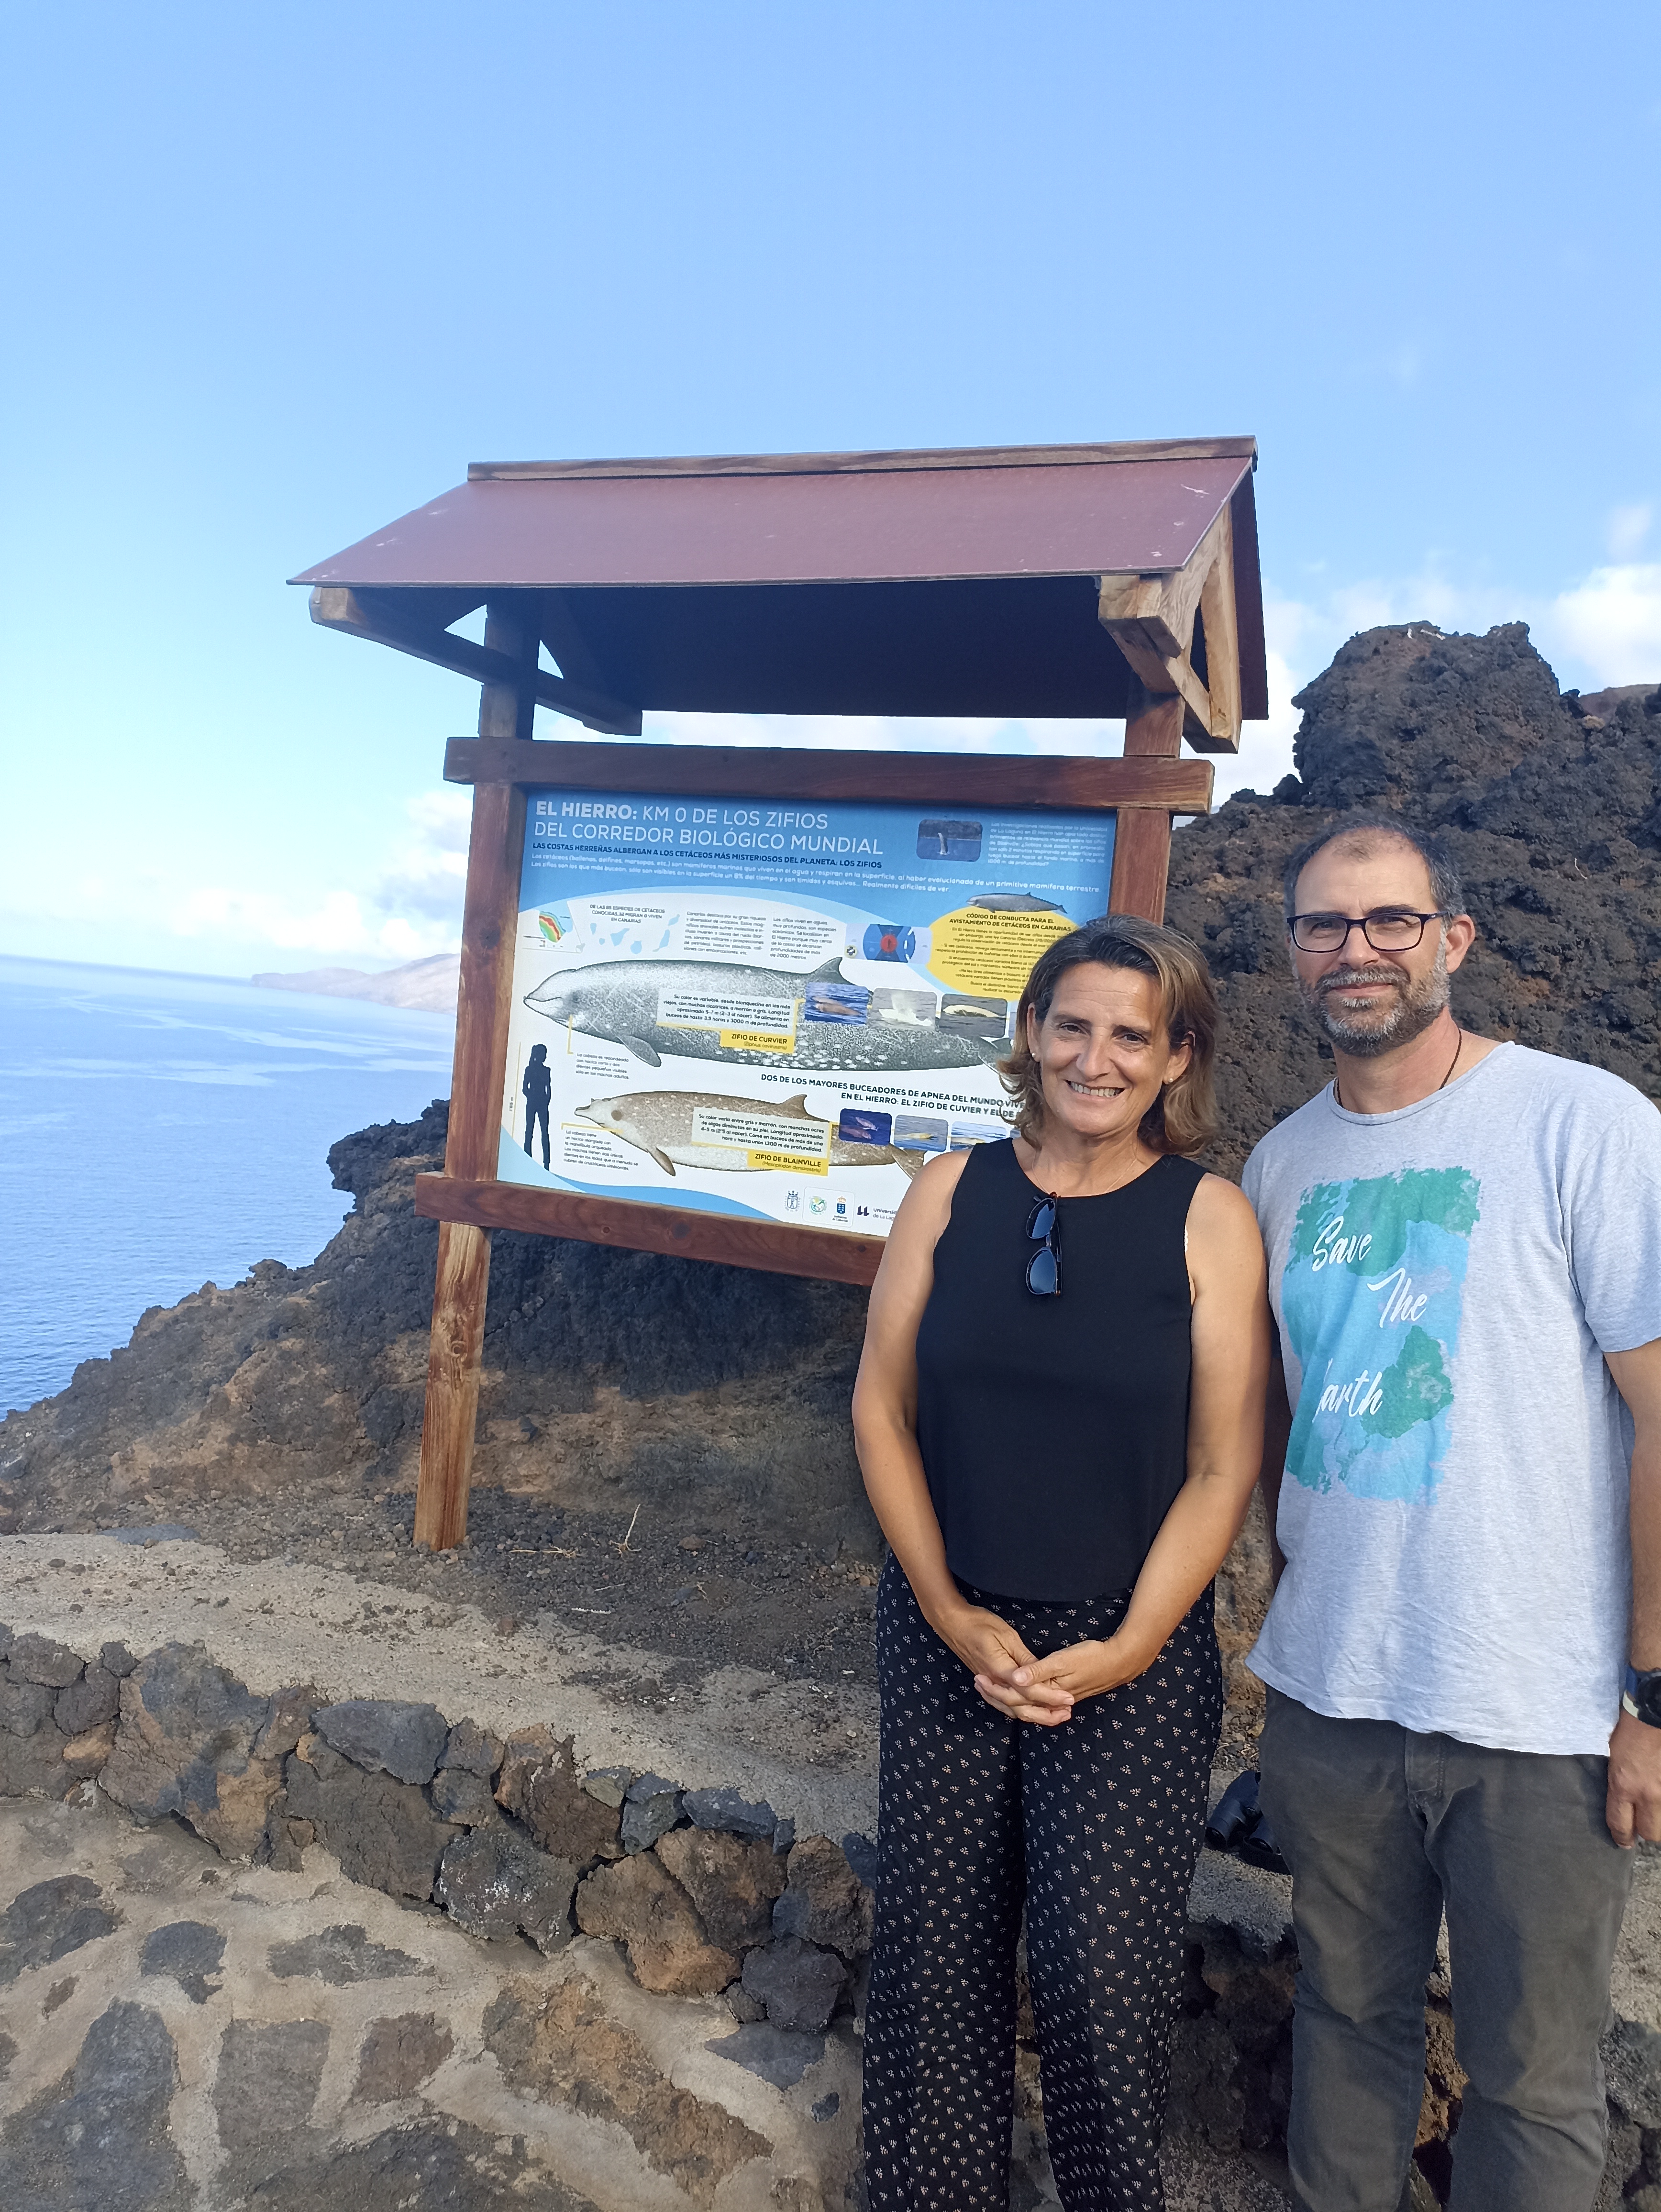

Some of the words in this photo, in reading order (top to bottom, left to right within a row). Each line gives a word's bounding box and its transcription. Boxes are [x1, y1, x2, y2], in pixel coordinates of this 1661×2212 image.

[536, 801, 557, 815] EL
[562, 802, 637, 819] HIERRO:
[643, 806, 668, 821] KM
[675, 807, 686, 822] 0
[693, 808, 717, 823] DE
[723, 810, 759, 826] LOS
[765, 812, 828, 829] ZIFIOS
[534, 821, 566, 837] DEL
[572, 824, 674, 842] CORREDOR
[680, 828, 784, 848] BIOLÓGICO
[791, 835, 883, 854] MUNDIAL
[731, 854, 782, 862] MISTERIOSOS
[809, 1079, 848, 1089] MAYORES
[850, 1084, 906, 1095] BUCEADORES
[920, 1091, 950, 1100] APNEA
[970, 1097, 1004, 1107] MUNDO
[1005, 1097, 1025, 1108] VIVE
[865, 1095, 898, 1104] HIERRO:
[950, 1104, 982, 1113] CUVIER
[783, 1157, 821, 1167] BLAINVILLE
[1311, 1216, 1372, 1271] Save
[1367, 1267, 1428, 1328] The
[1312, 1358, 1383, 1423] arth
